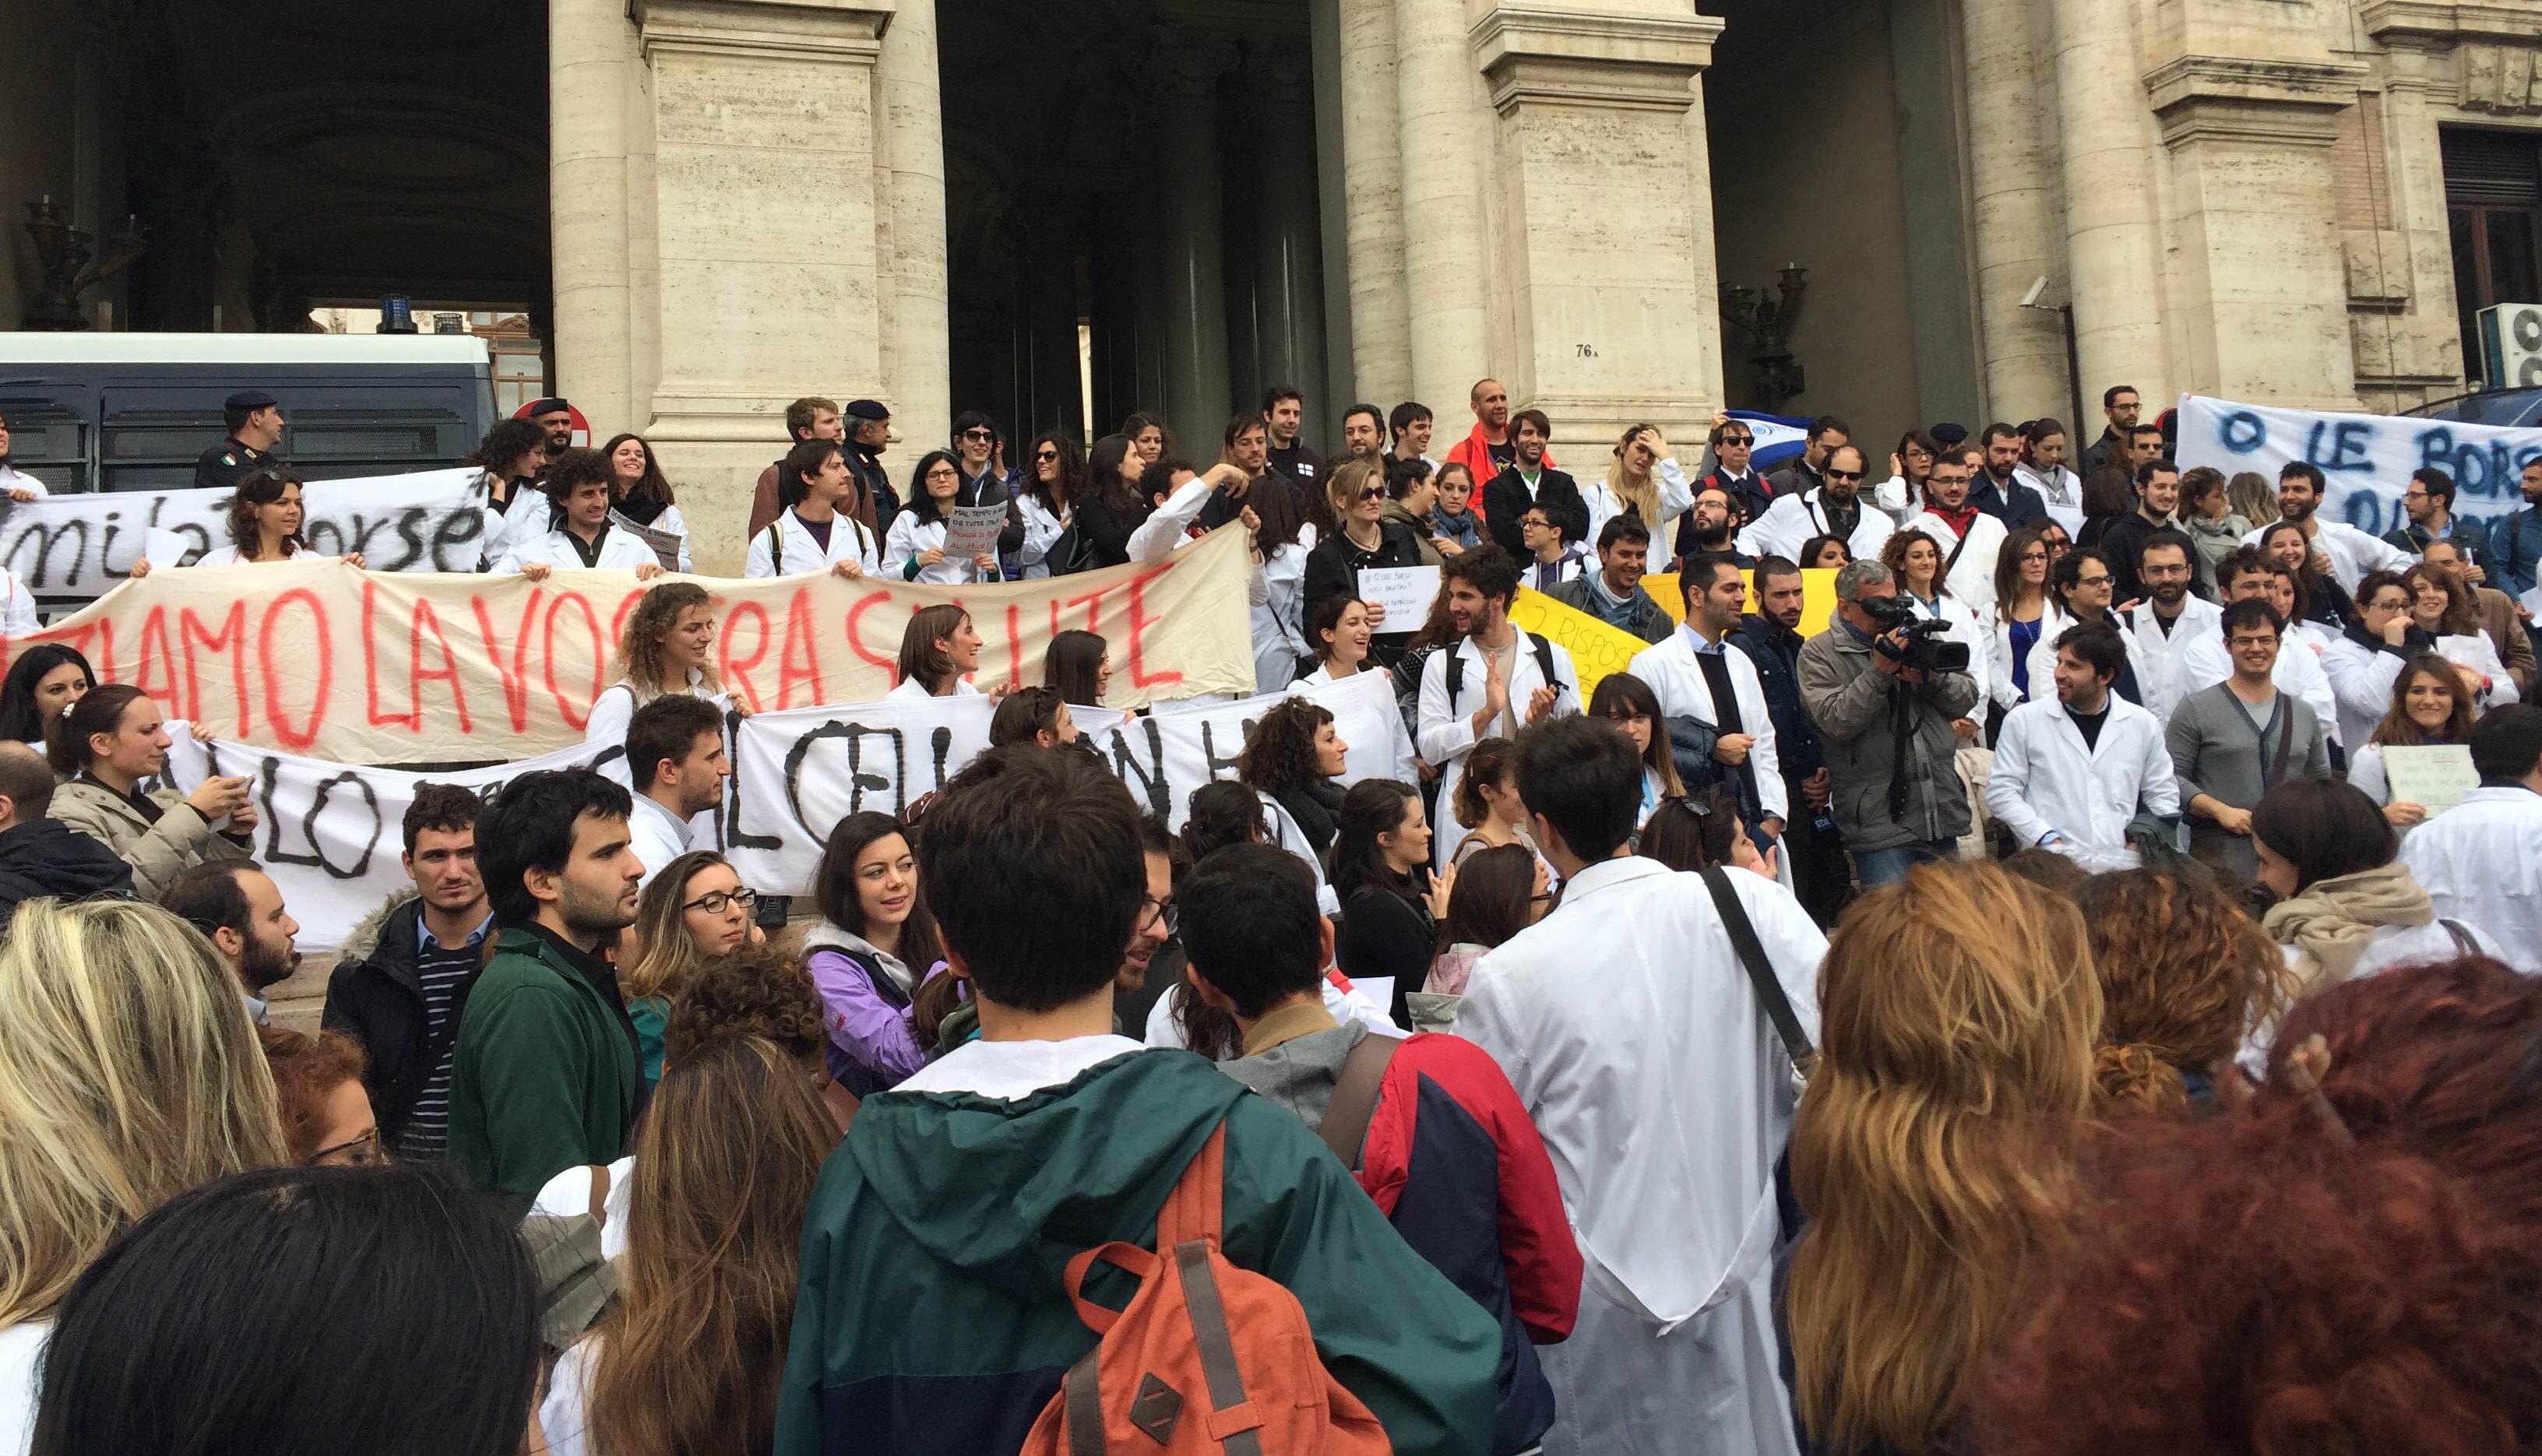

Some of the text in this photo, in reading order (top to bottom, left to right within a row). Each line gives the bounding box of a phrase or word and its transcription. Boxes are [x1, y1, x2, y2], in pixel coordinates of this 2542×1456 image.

[2306, 420, 2375, 472] LE
[0, 588, 333, 749] IAMO
[361, 579, 474, 734] LA
